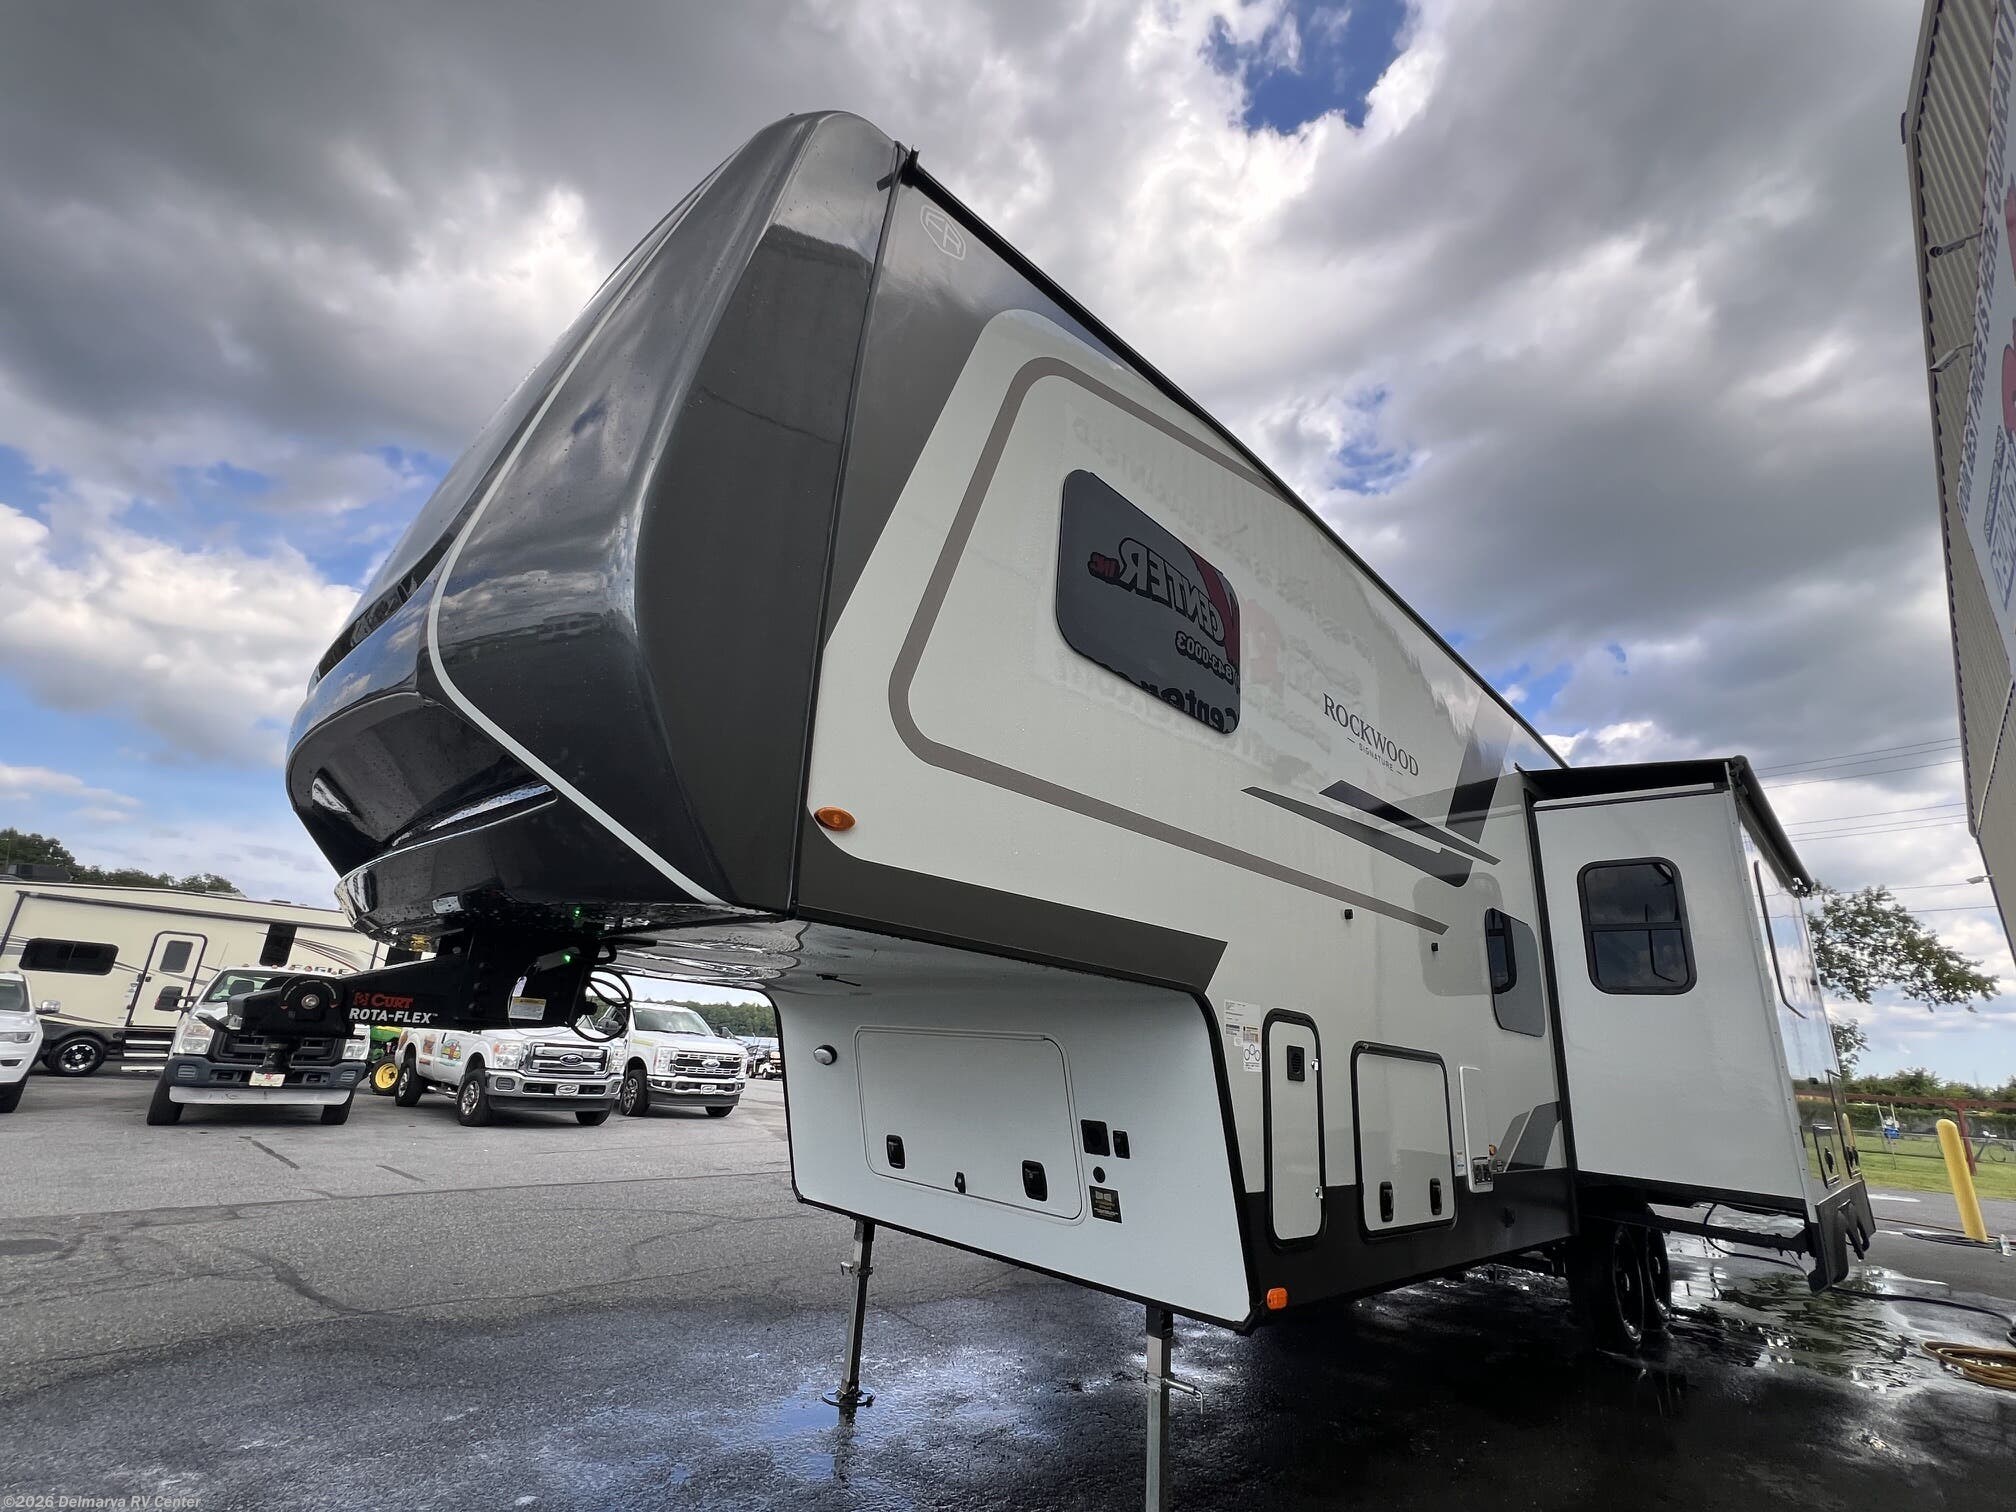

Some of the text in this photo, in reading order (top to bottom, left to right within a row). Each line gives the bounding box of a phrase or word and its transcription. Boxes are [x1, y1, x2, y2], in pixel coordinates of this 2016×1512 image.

[1987, 0, 2016, 215] GUARANT
[1980, 206, 1999, 310] HERE
[1969, 330, 1986, 420] PRICE
[1323, 692, 1419, 777] ROCKWOOD
